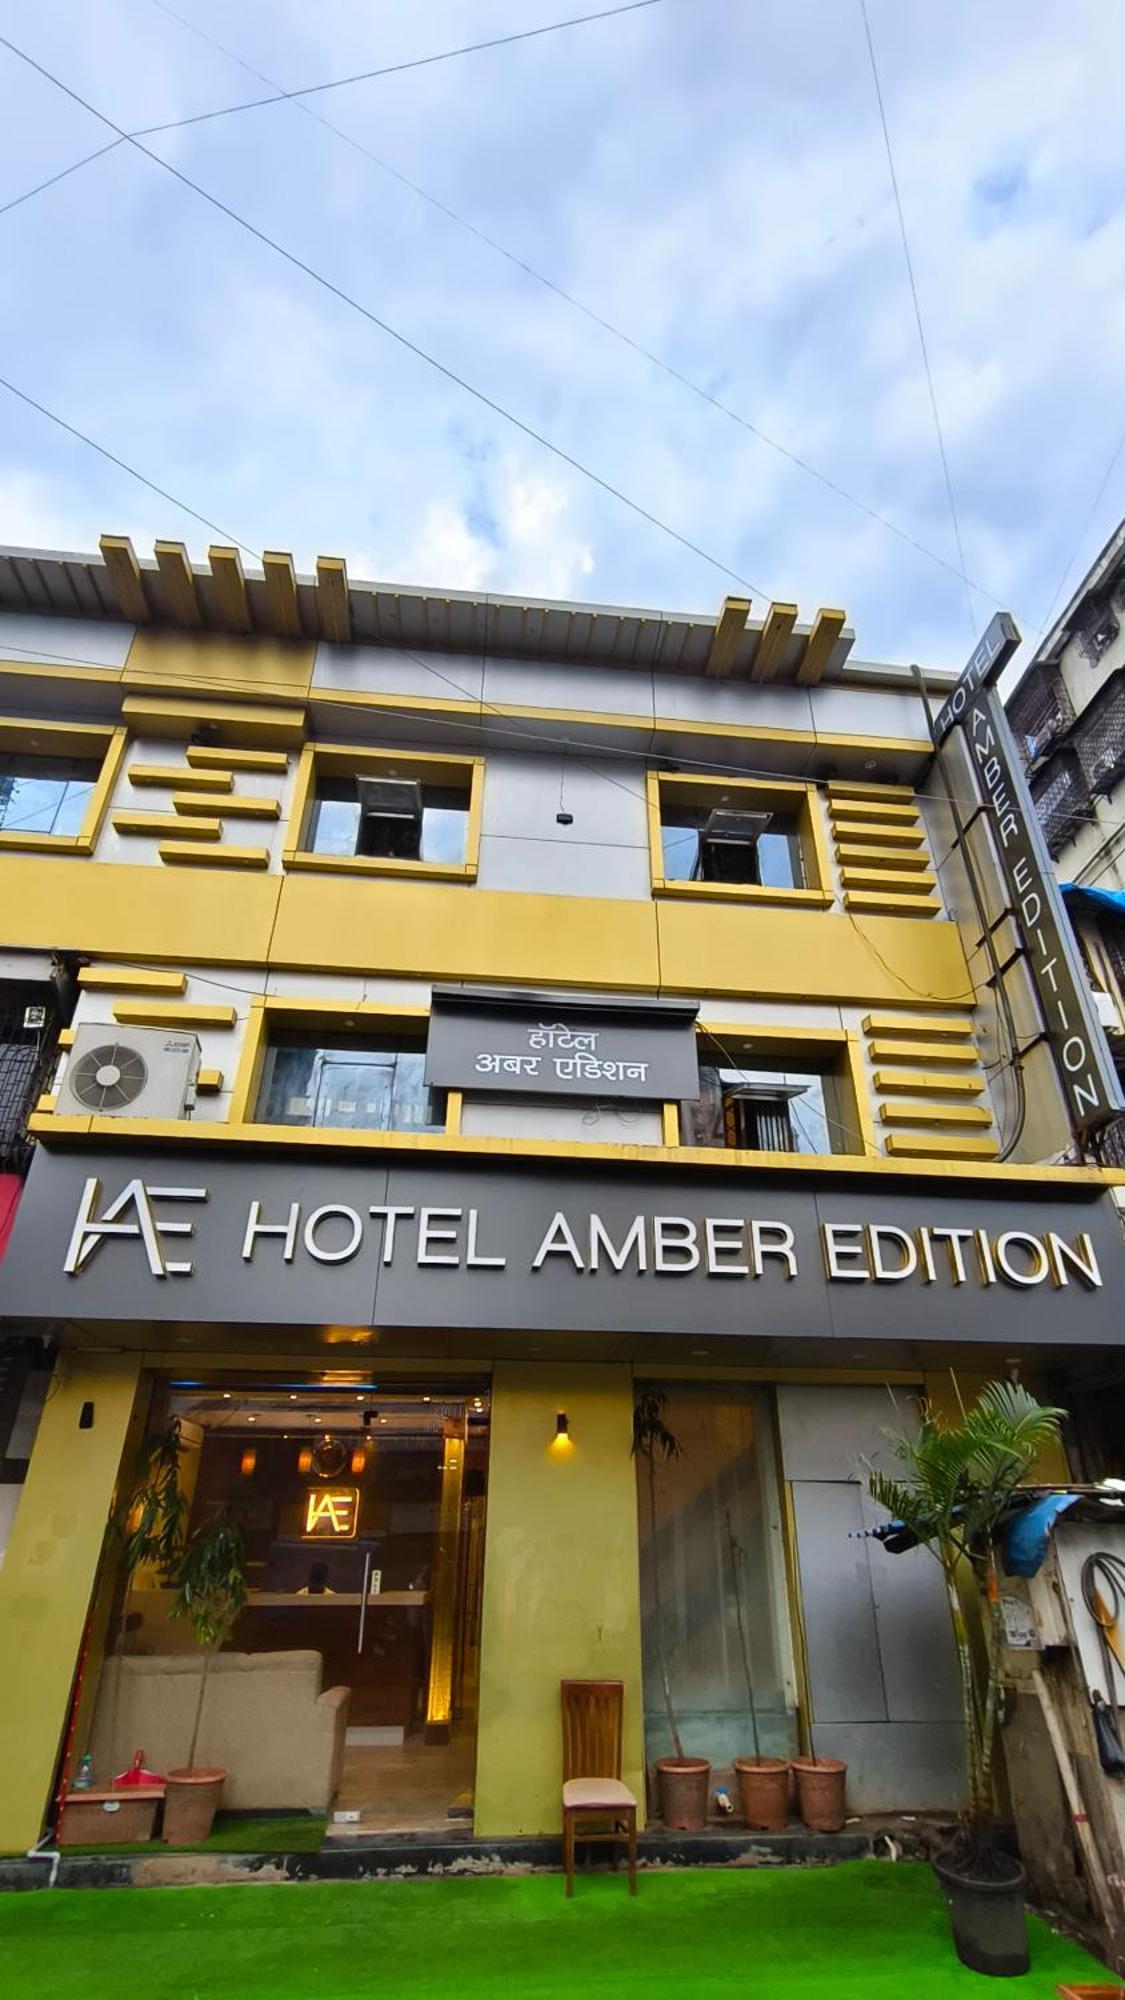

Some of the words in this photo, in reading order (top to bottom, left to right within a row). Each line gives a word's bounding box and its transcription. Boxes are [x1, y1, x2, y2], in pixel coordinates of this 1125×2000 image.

[939, 639, 1001, 732] HOTEL
[972, 707, 1019, 849] AMBER
[1012, 857, 1100, 1118] EDITION
[474, 1053, 542, 1077] अबर
[553, 1052, 649, 1083] एडिशन
[528, 1022, 599, 1051] हॉटेल
[241, 1201, 507, 1266] HOTEL
[531, 1211, 799, 1279] AMBER
[822, 1221, 1104, 1289] EDITION
